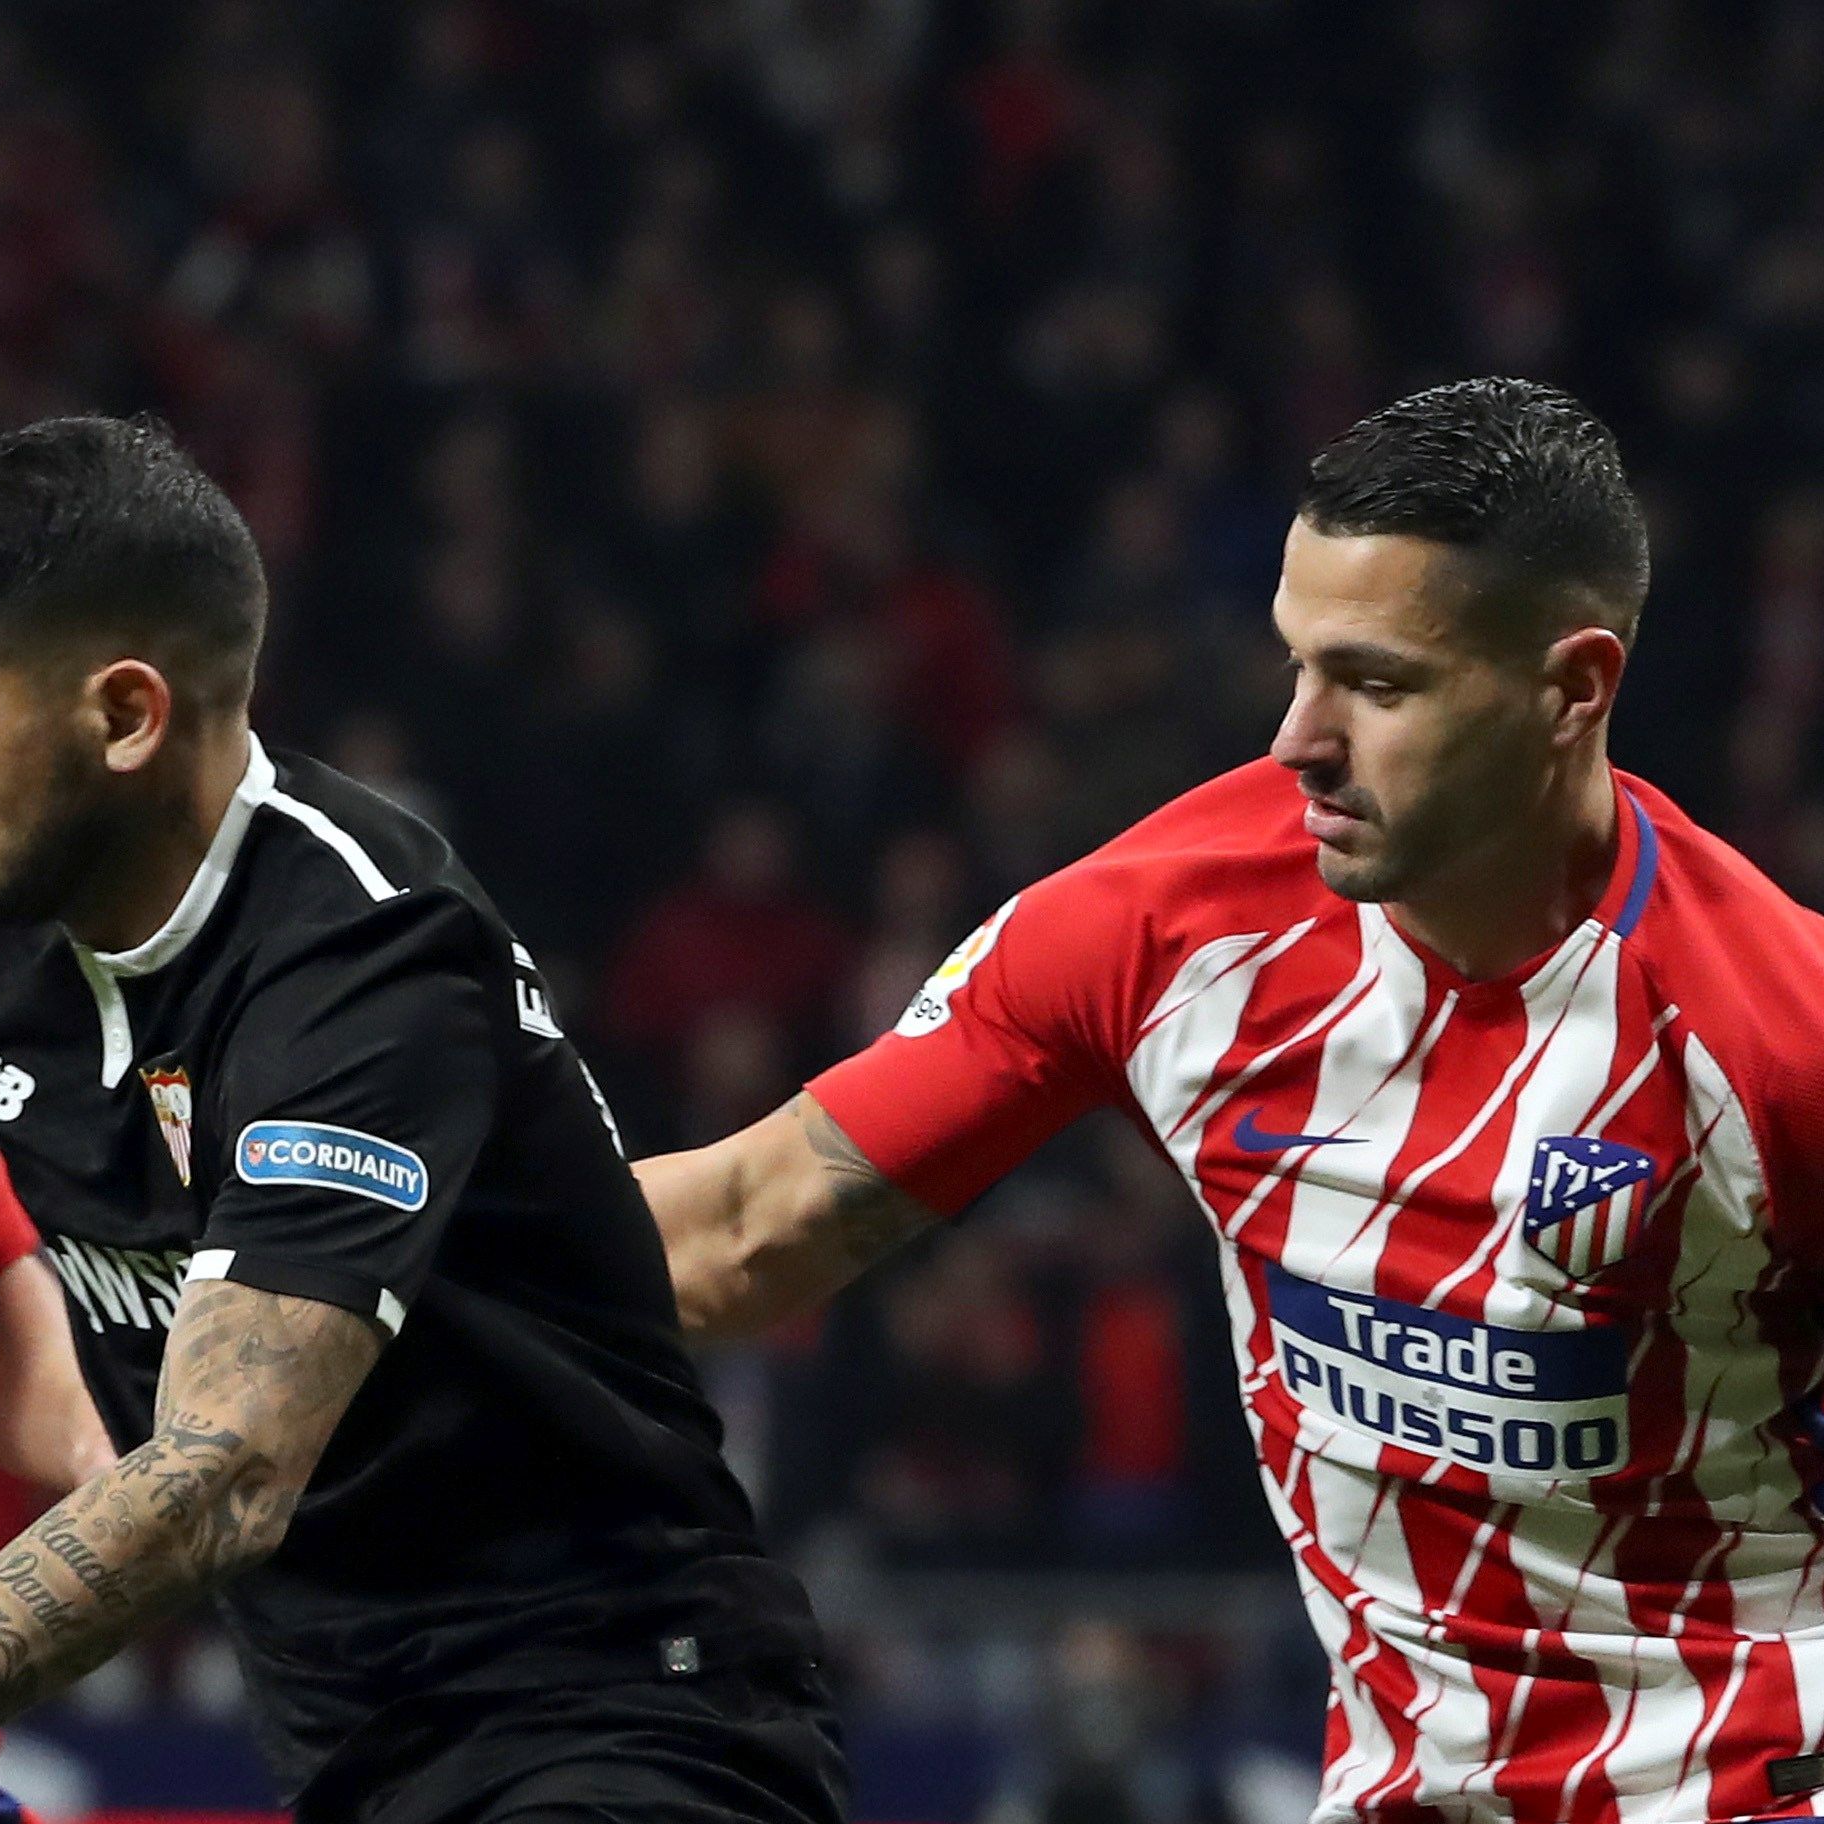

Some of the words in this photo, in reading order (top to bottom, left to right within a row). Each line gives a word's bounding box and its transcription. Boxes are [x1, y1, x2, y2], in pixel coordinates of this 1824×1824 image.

[268, 1139, 419, 1194] CORDIALITY
[1328, 1296, 1537, 1392] Trade
[1281, 1339, 1619, 1471] Plus500
